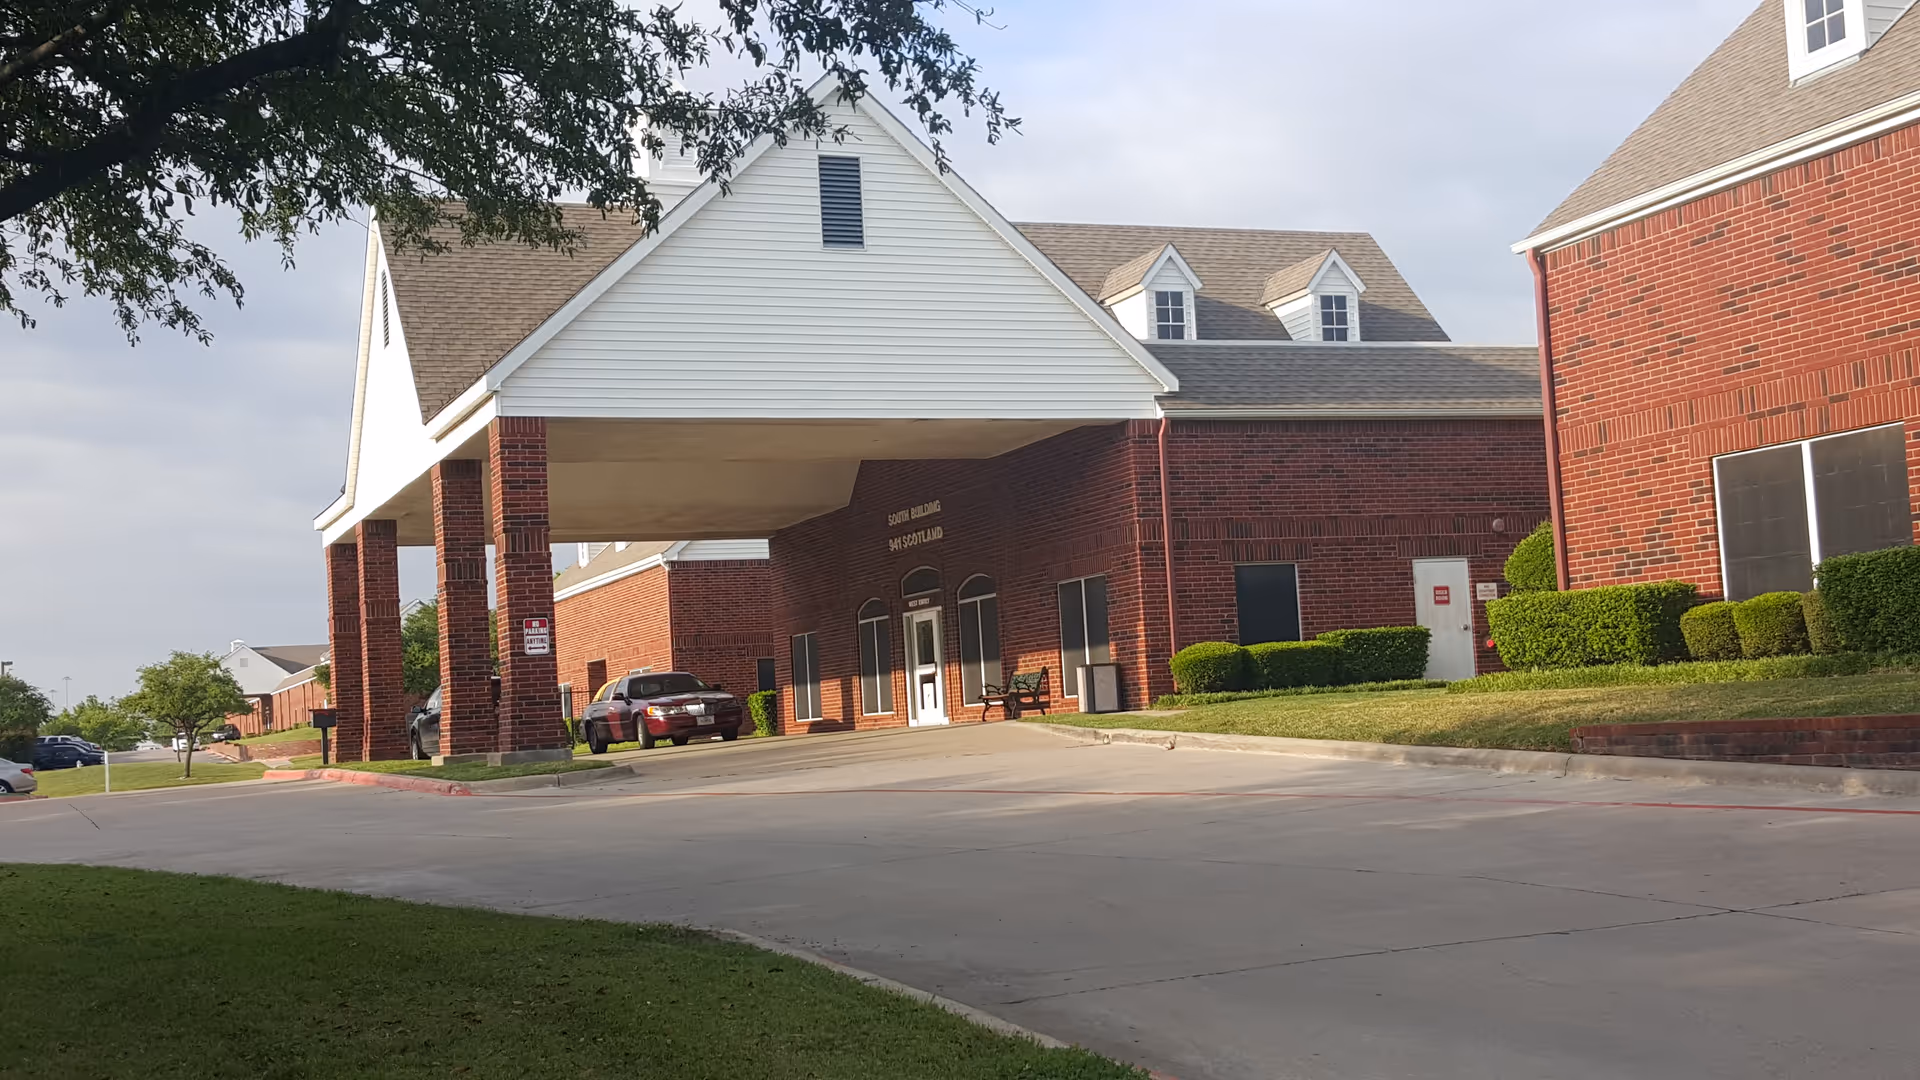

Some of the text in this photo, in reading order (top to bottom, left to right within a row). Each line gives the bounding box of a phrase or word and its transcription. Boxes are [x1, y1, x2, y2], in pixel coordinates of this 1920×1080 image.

[888, 500, 941, 527] SOUTH BUILDING
[888, 527, 943, 552] 941 SCOTLAND
